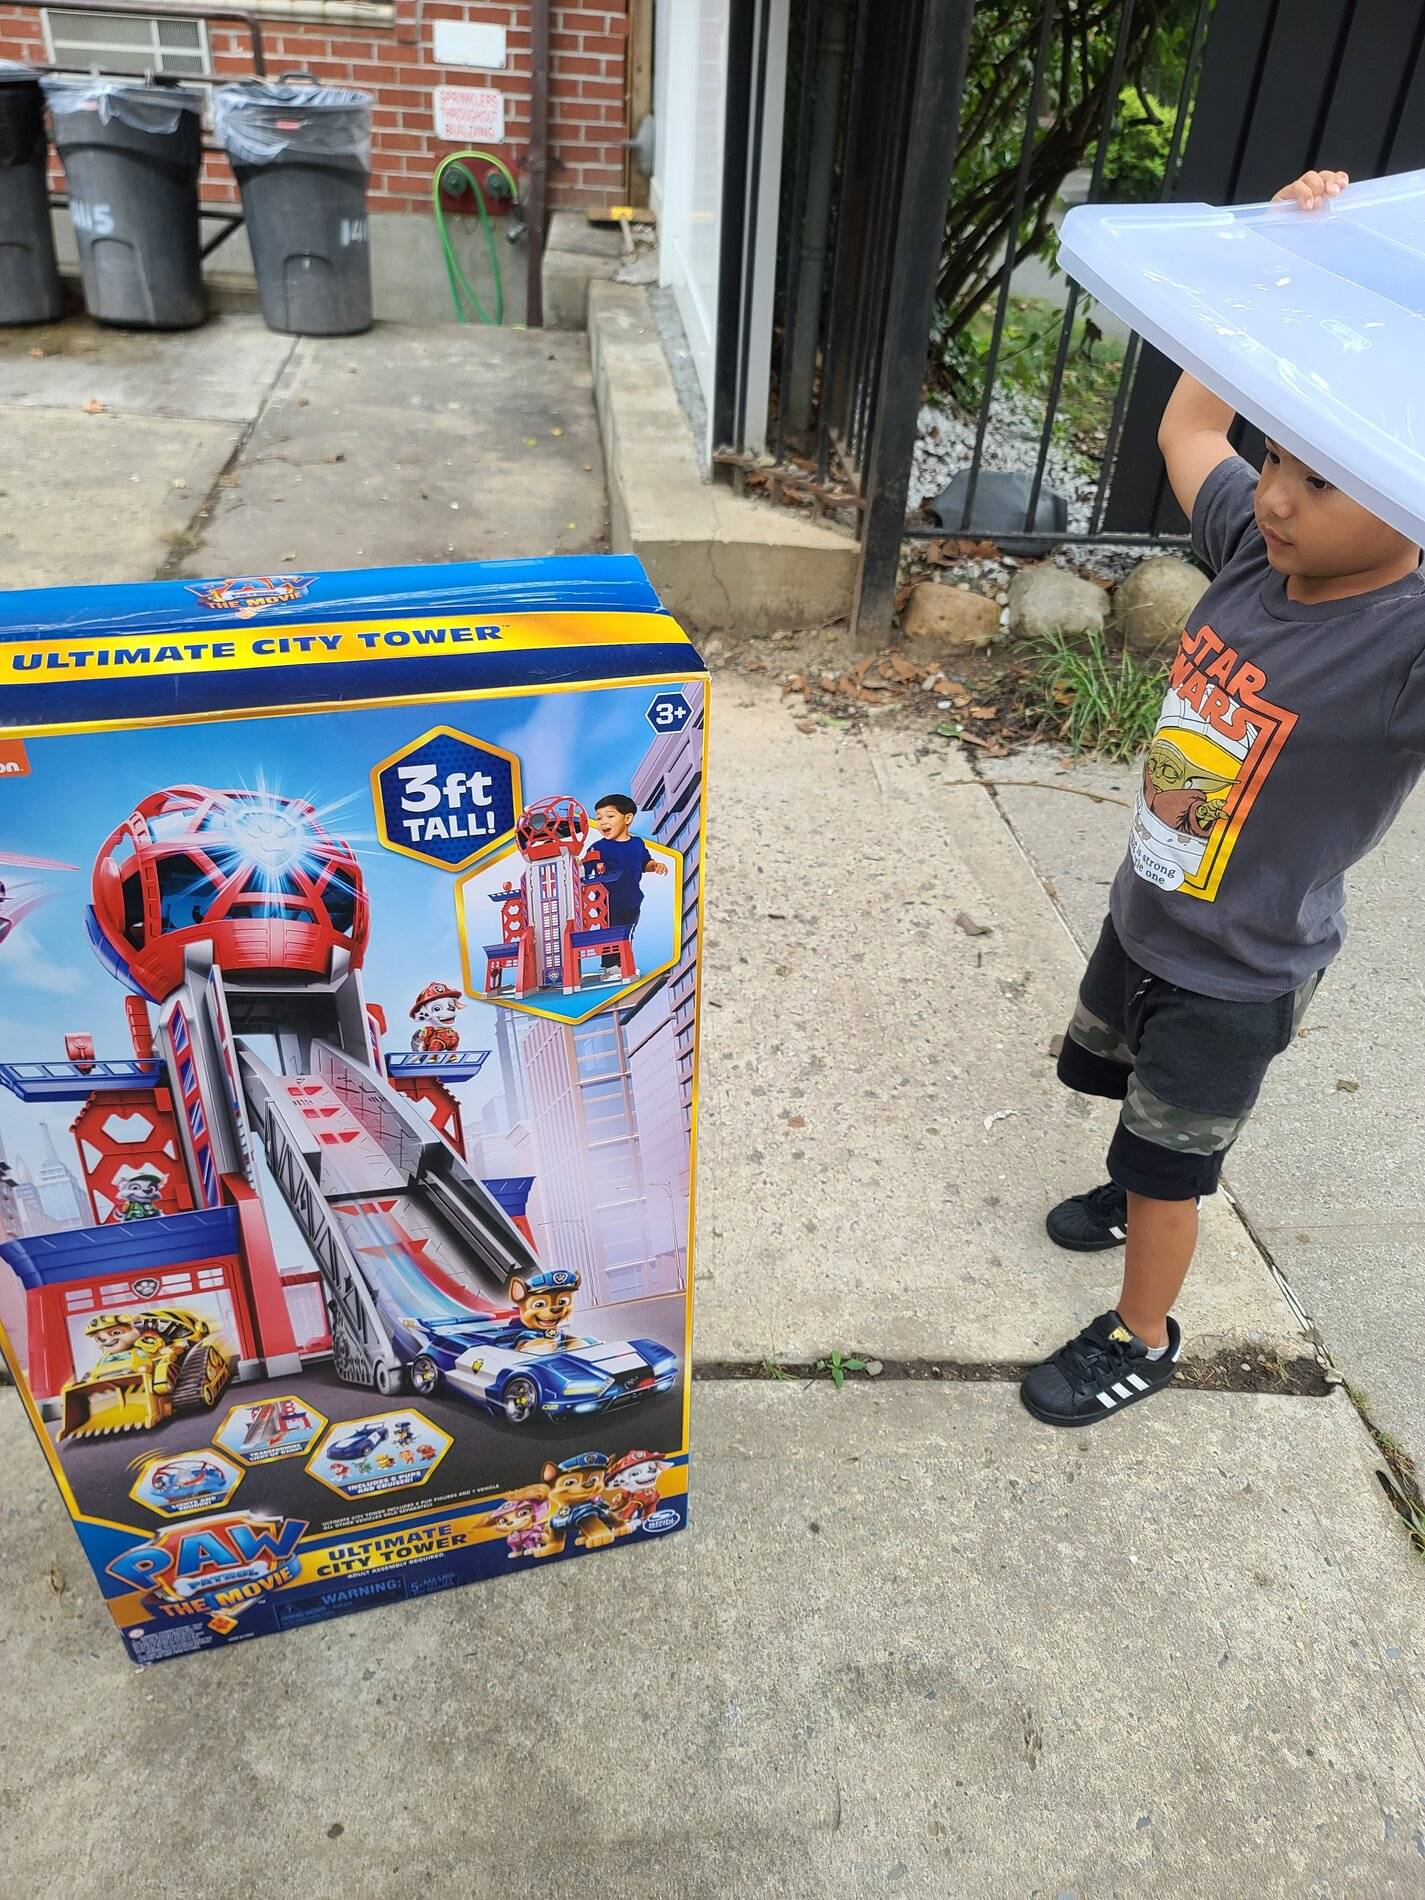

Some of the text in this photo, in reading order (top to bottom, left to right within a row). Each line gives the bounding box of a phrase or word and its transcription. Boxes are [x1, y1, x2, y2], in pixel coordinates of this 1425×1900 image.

[245, 590, 303, 608] MOVIE
[12, 625, 503, 671] ULTIMATE CITY TOWER
[1180, 624, 1267, 700] STAR
[1168, 652, 1256, 742] WARS
[655, 703, 687, 726] 3+
[397, 763, 493, 813] 3ft
[402, 811, 496, 842] TALL!
[1142, 853, 1176, 879] strong
[1145, 869, 1165, 885] one
[458, 1489, 471, 1497] AND
[476, 1483, 500, 1493] VEHICLE
[105, 1518, 310, 1592] PAW
[316, 1533, 468, 1577] CITY TOWER
[328, 1524, 453, 1561] ULTIMATE
[347, 1568, 371, 1580] ADULT
[371, 1561, 408, 1574] ASSEMBLY
[158, 1566, 293, 1617] THE MOVIE
[321, 1579, 401, 1606] WARNING:
